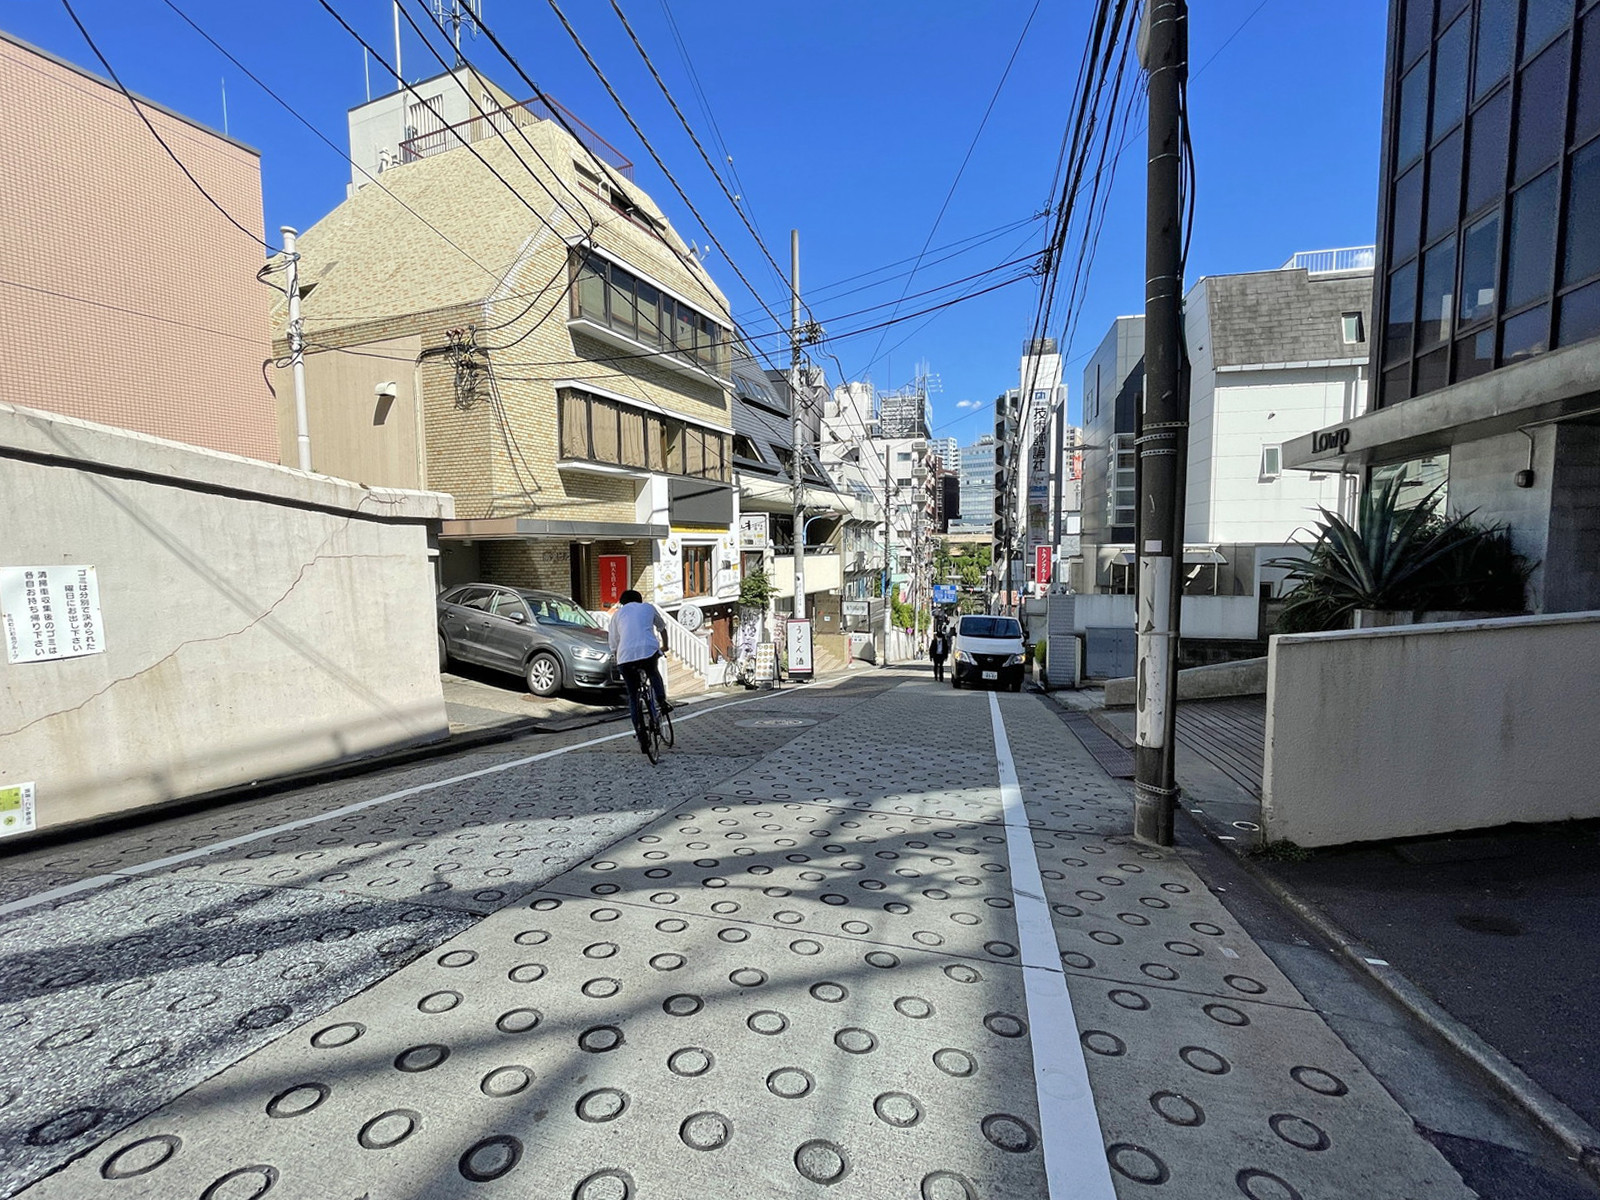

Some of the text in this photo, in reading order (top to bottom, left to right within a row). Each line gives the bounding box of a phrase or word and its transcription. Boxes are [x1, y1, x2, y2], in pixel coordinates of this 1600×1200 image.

[1033, 407, 1047, 472] 技術評論社
[24, 571, 45, 656] 各自お持ち帰り下さい
[37, 571, 58, 655] 清掃車収集後のゴミは
[64, 585, 83, 652] 曜日にお出し下さい
[77, 569, 97, 651] ゴミは分別で決められた
